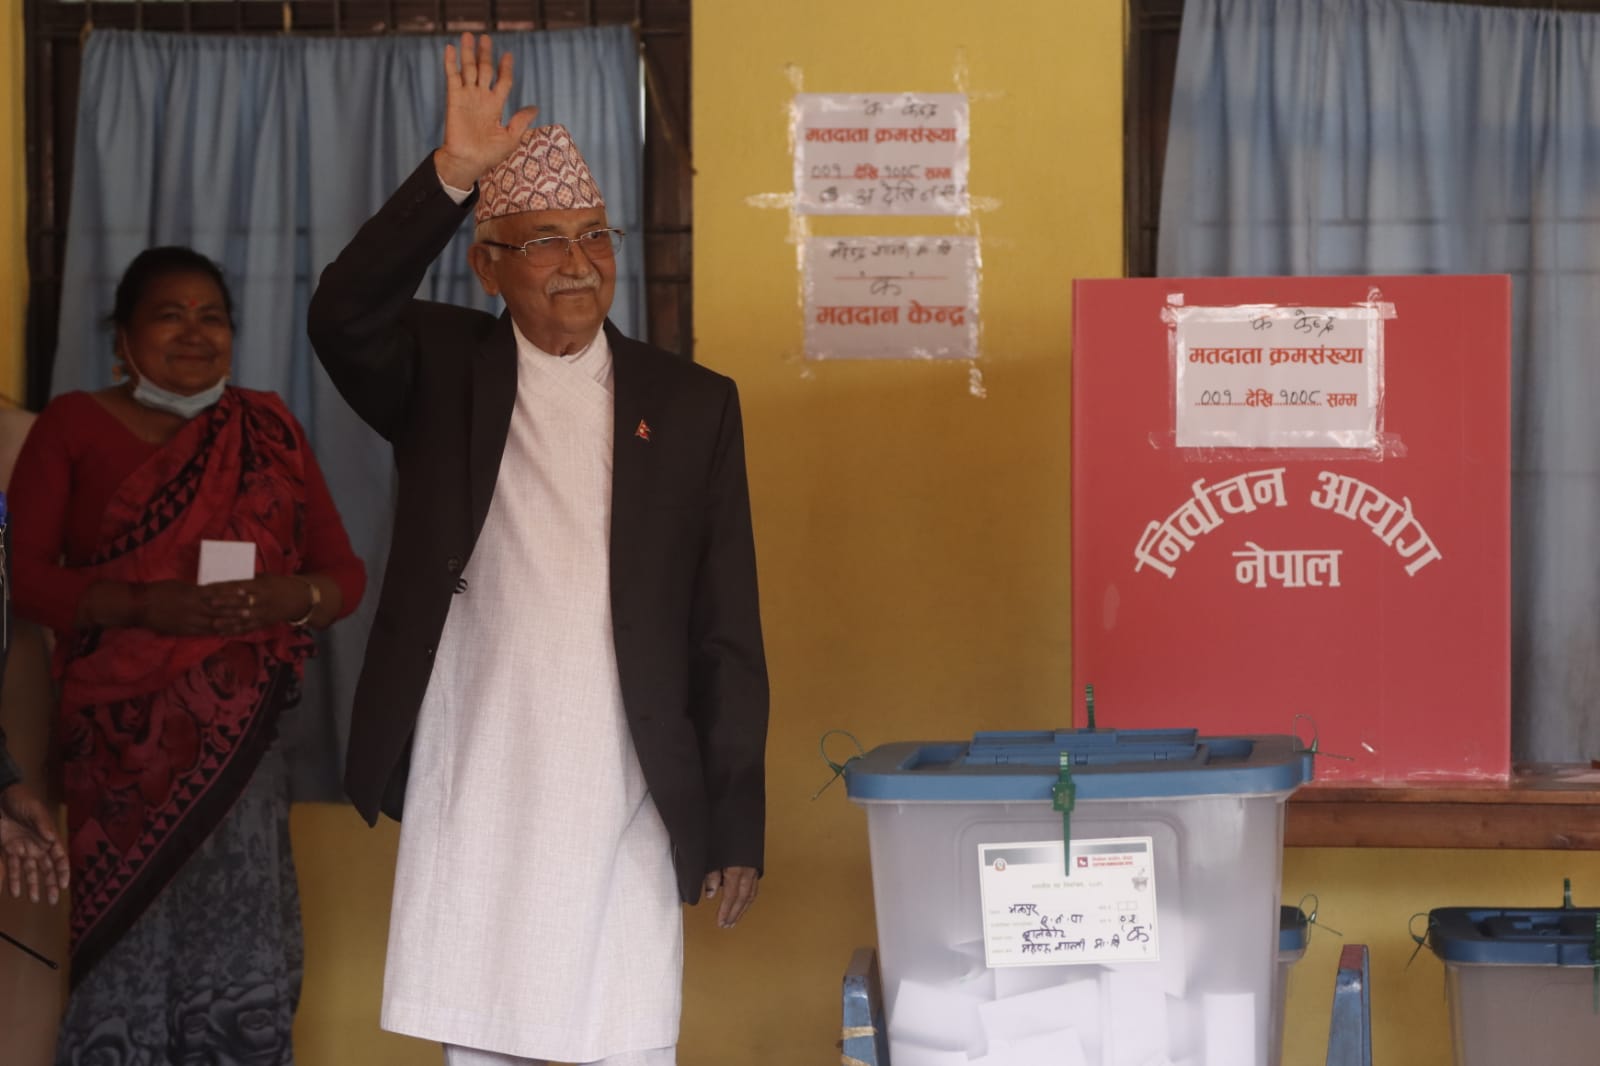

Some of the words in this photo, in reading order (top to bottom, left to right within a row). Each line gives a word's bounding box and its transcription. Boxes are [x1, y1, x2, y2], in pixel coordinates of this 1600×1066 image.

[805, 127, 869, 143] मतदाता
[874, 126, 957, 144] क्रमसंख्या
[816, 305, 900, 325] मतदान
[907, 300, 967, 326] केन्द्र
[1189, 348, 1263, 365] मतदाता
[1269, 344, 1364, 366] क्रमसंख्या
[1245, 388, 1273, 407] देखि
[1326, 393, 1358, 407] सम्म
[1135, 467, 1288, 579] निर्वाचन
[1310, 471, 1442, 577] आयोग
[1232, 541, 1343, 588] नेपाल
